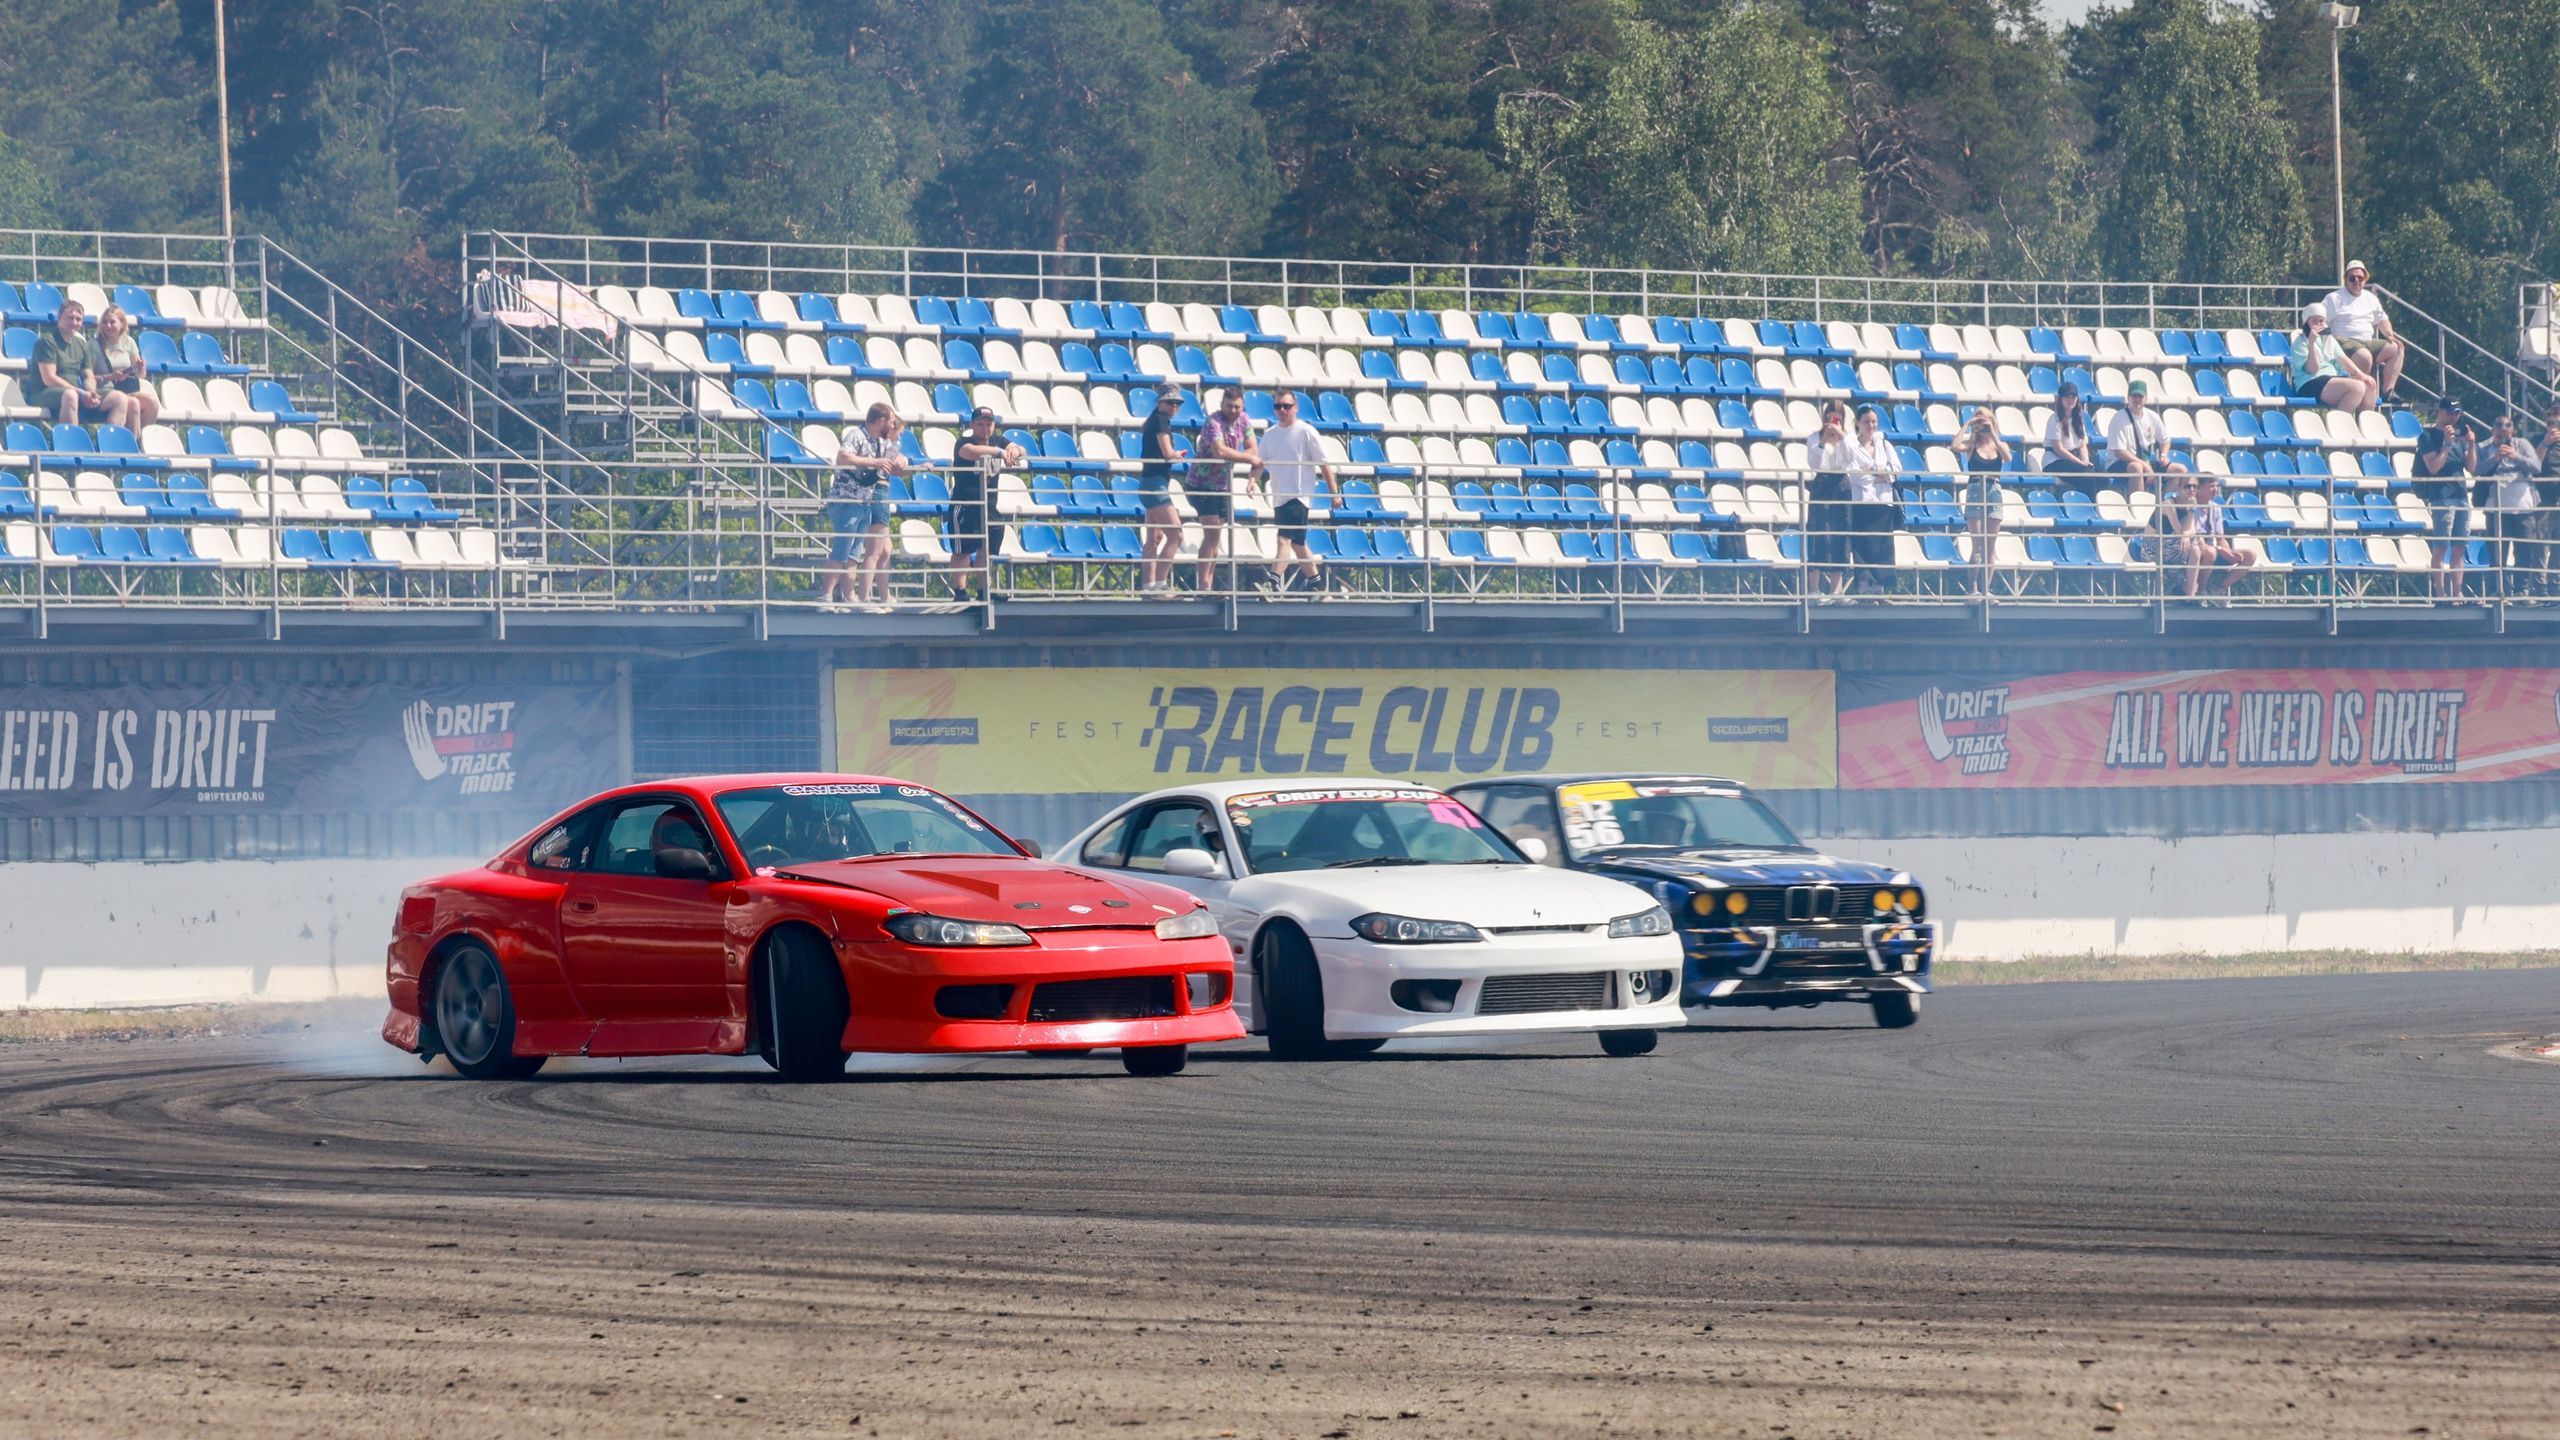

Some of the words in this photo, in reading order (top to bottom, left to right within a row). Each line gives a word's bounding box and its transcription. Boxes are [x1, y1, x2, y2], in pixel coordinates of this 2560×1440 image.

[1945, 688, 2009, 720] DRIFT
[436, 701, 515, 736] DRIFT
[1030, 722, 1123, 738] FEST
[1140, 686, 1364, 773] RACE
[1369, 686, 1561, 773] CLUB
[1576, 721, 1662, 737] FEST
[2106, 694, 2164, 763] ALL
[2178, 692, 2227, 763] WE
[2237, 693, 2321, 762] NEED
[2330, 693, 2363, 761] IS
[2371, 692, 2465, 761] DRIFT
[93, 709, 138, 790] IS
[151, 709, 276, 788] DRIFT
[1955, 734, 2006, 755] TRACK
[451, 752, 512, 775] TRACK
[1963, 752, 2010, 773] MODE
[2405, 763, 2454, 772] DRIFTEXPO.RU
[460, 772, 516, 794] MODE
[197, 791, 265, 802] DRIFTEXPO.RU
[1276, 791, 1338, 803] DRIFT
[1338, 790, 1396, 800] EXPO
[1396, 790, 1440, 801] CUP
[1565, 821, 1625, 849] 56
